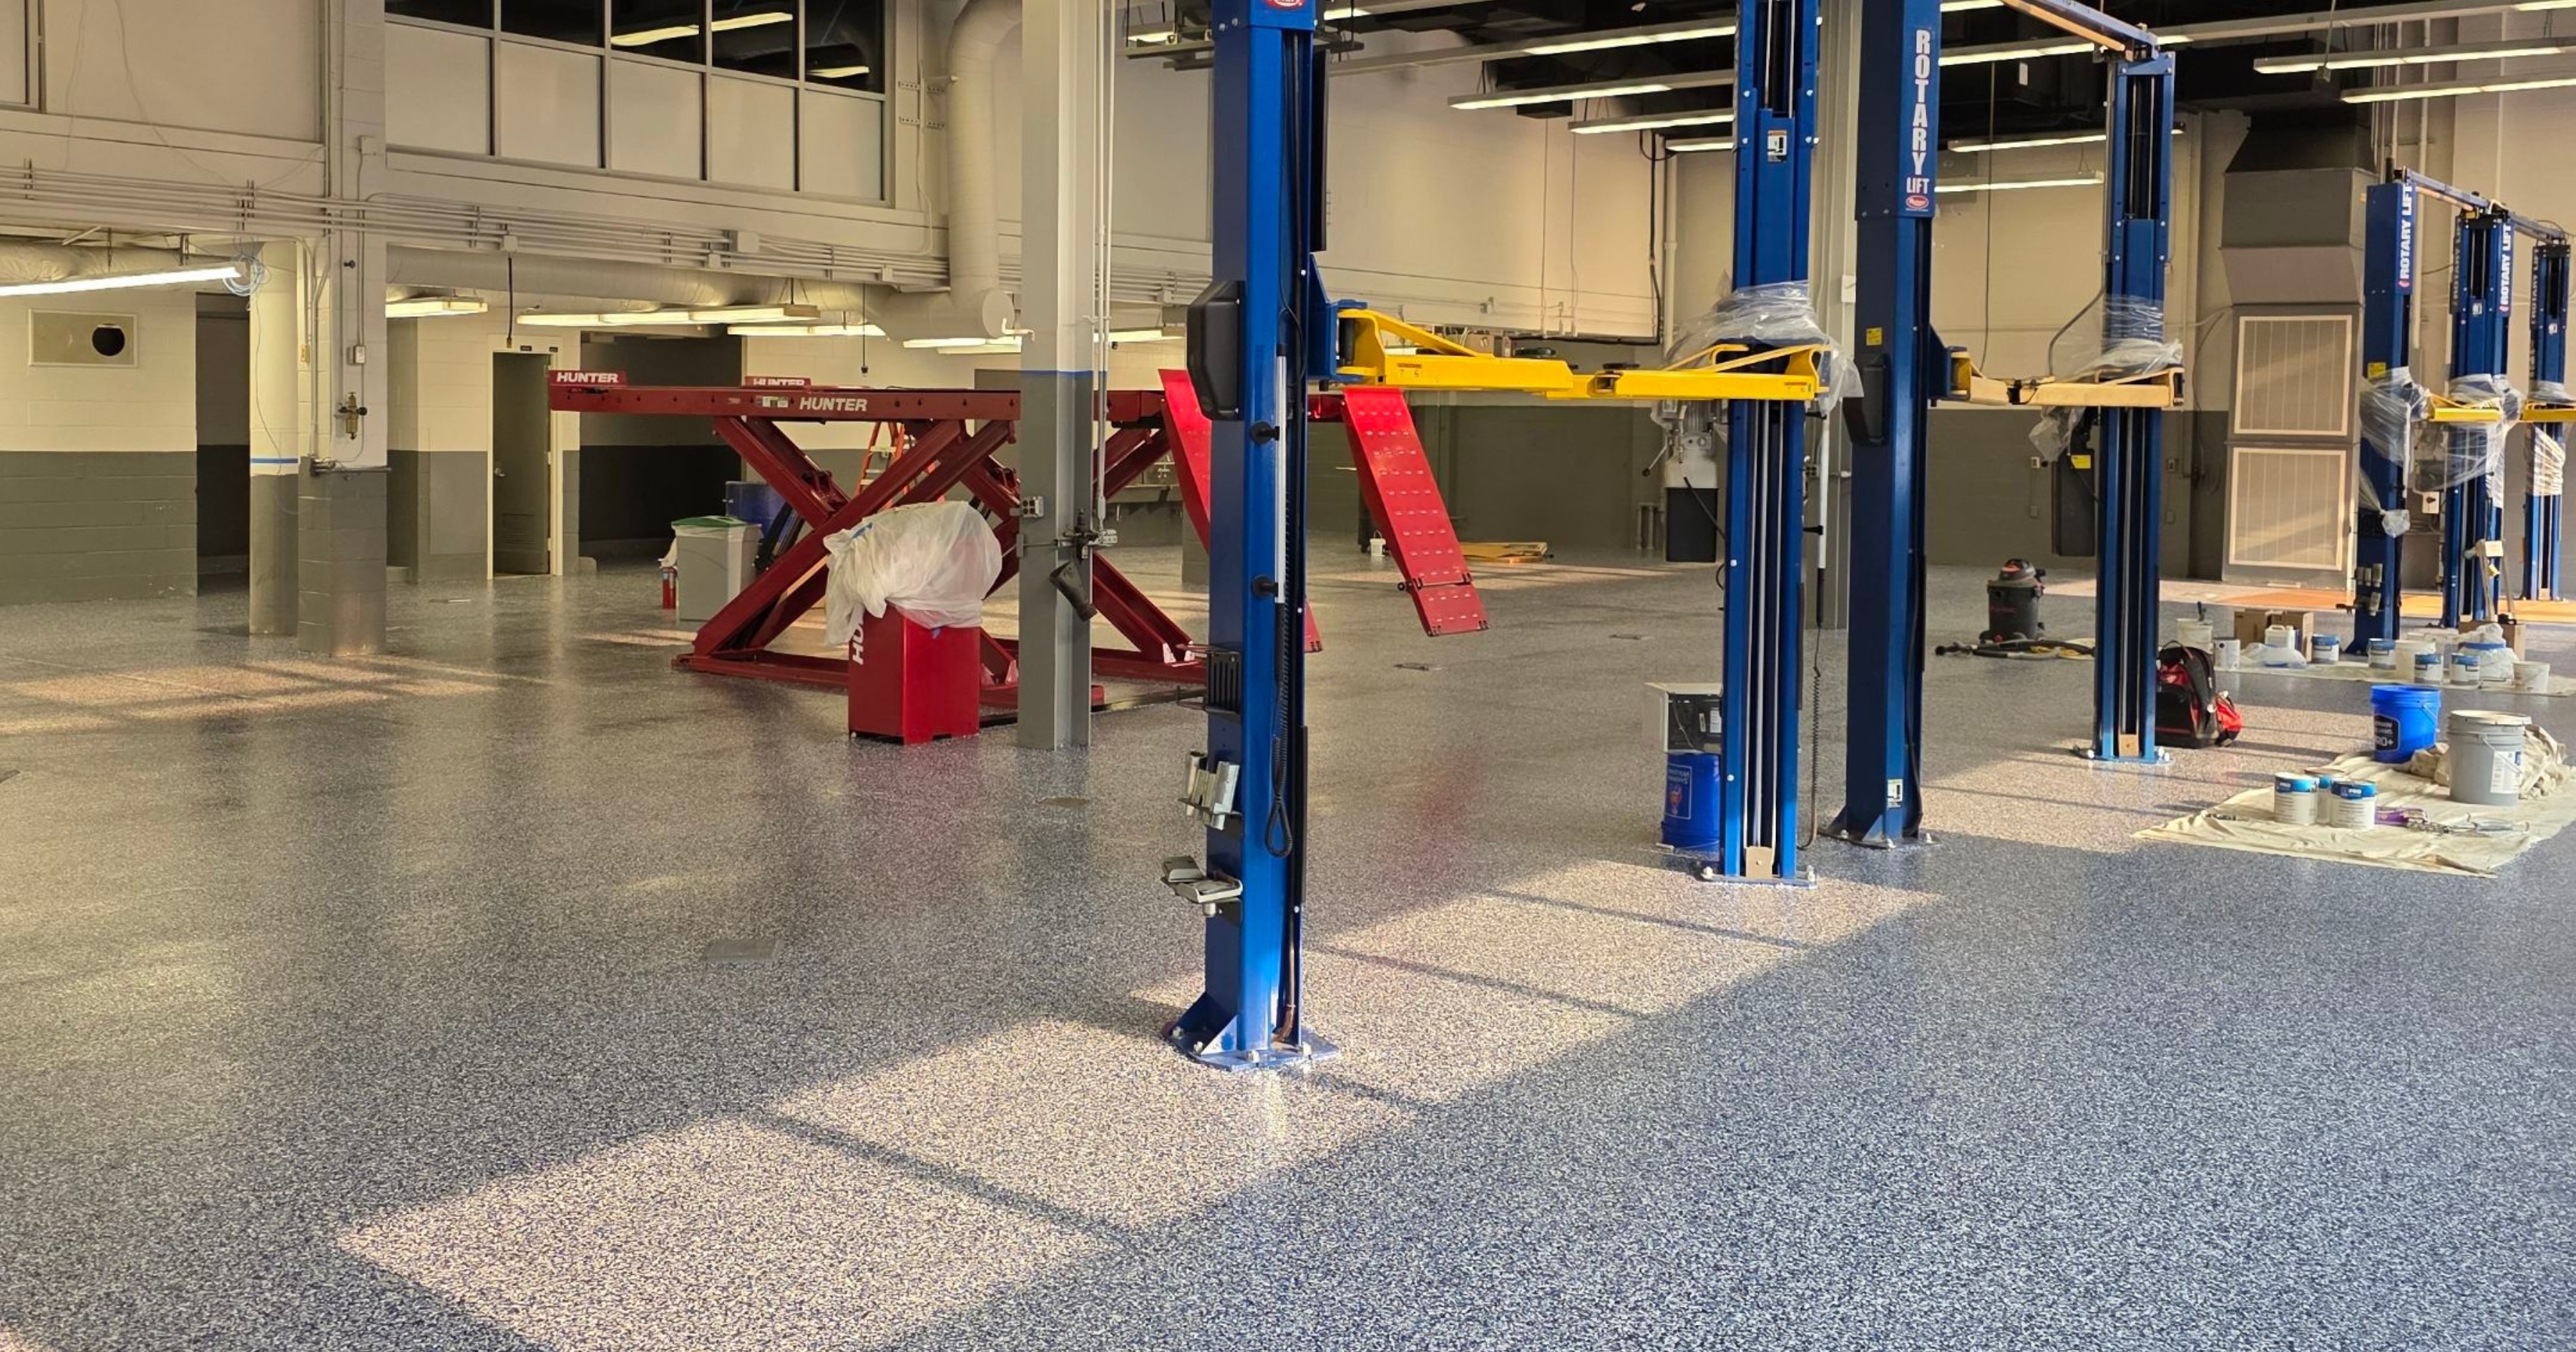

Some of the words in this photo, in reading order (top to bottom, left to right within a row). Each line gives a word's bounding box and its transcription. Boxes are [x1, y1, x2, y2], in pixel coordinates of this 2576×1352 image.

[1912, 29, 1931, 175] ROTARY
[1906, 177, 1930, 194] LIFT
[2402, 184, 2412, 215] LIFT
[2399, 219, 2411, 279] ROTARY
[2502, 222, 2511, 251] LIFT
[2500, 254, 2509, 305] ROTARY
[557, 372, 619, 383] HUNTER
[799, 397, 868, 411] HUNTER
